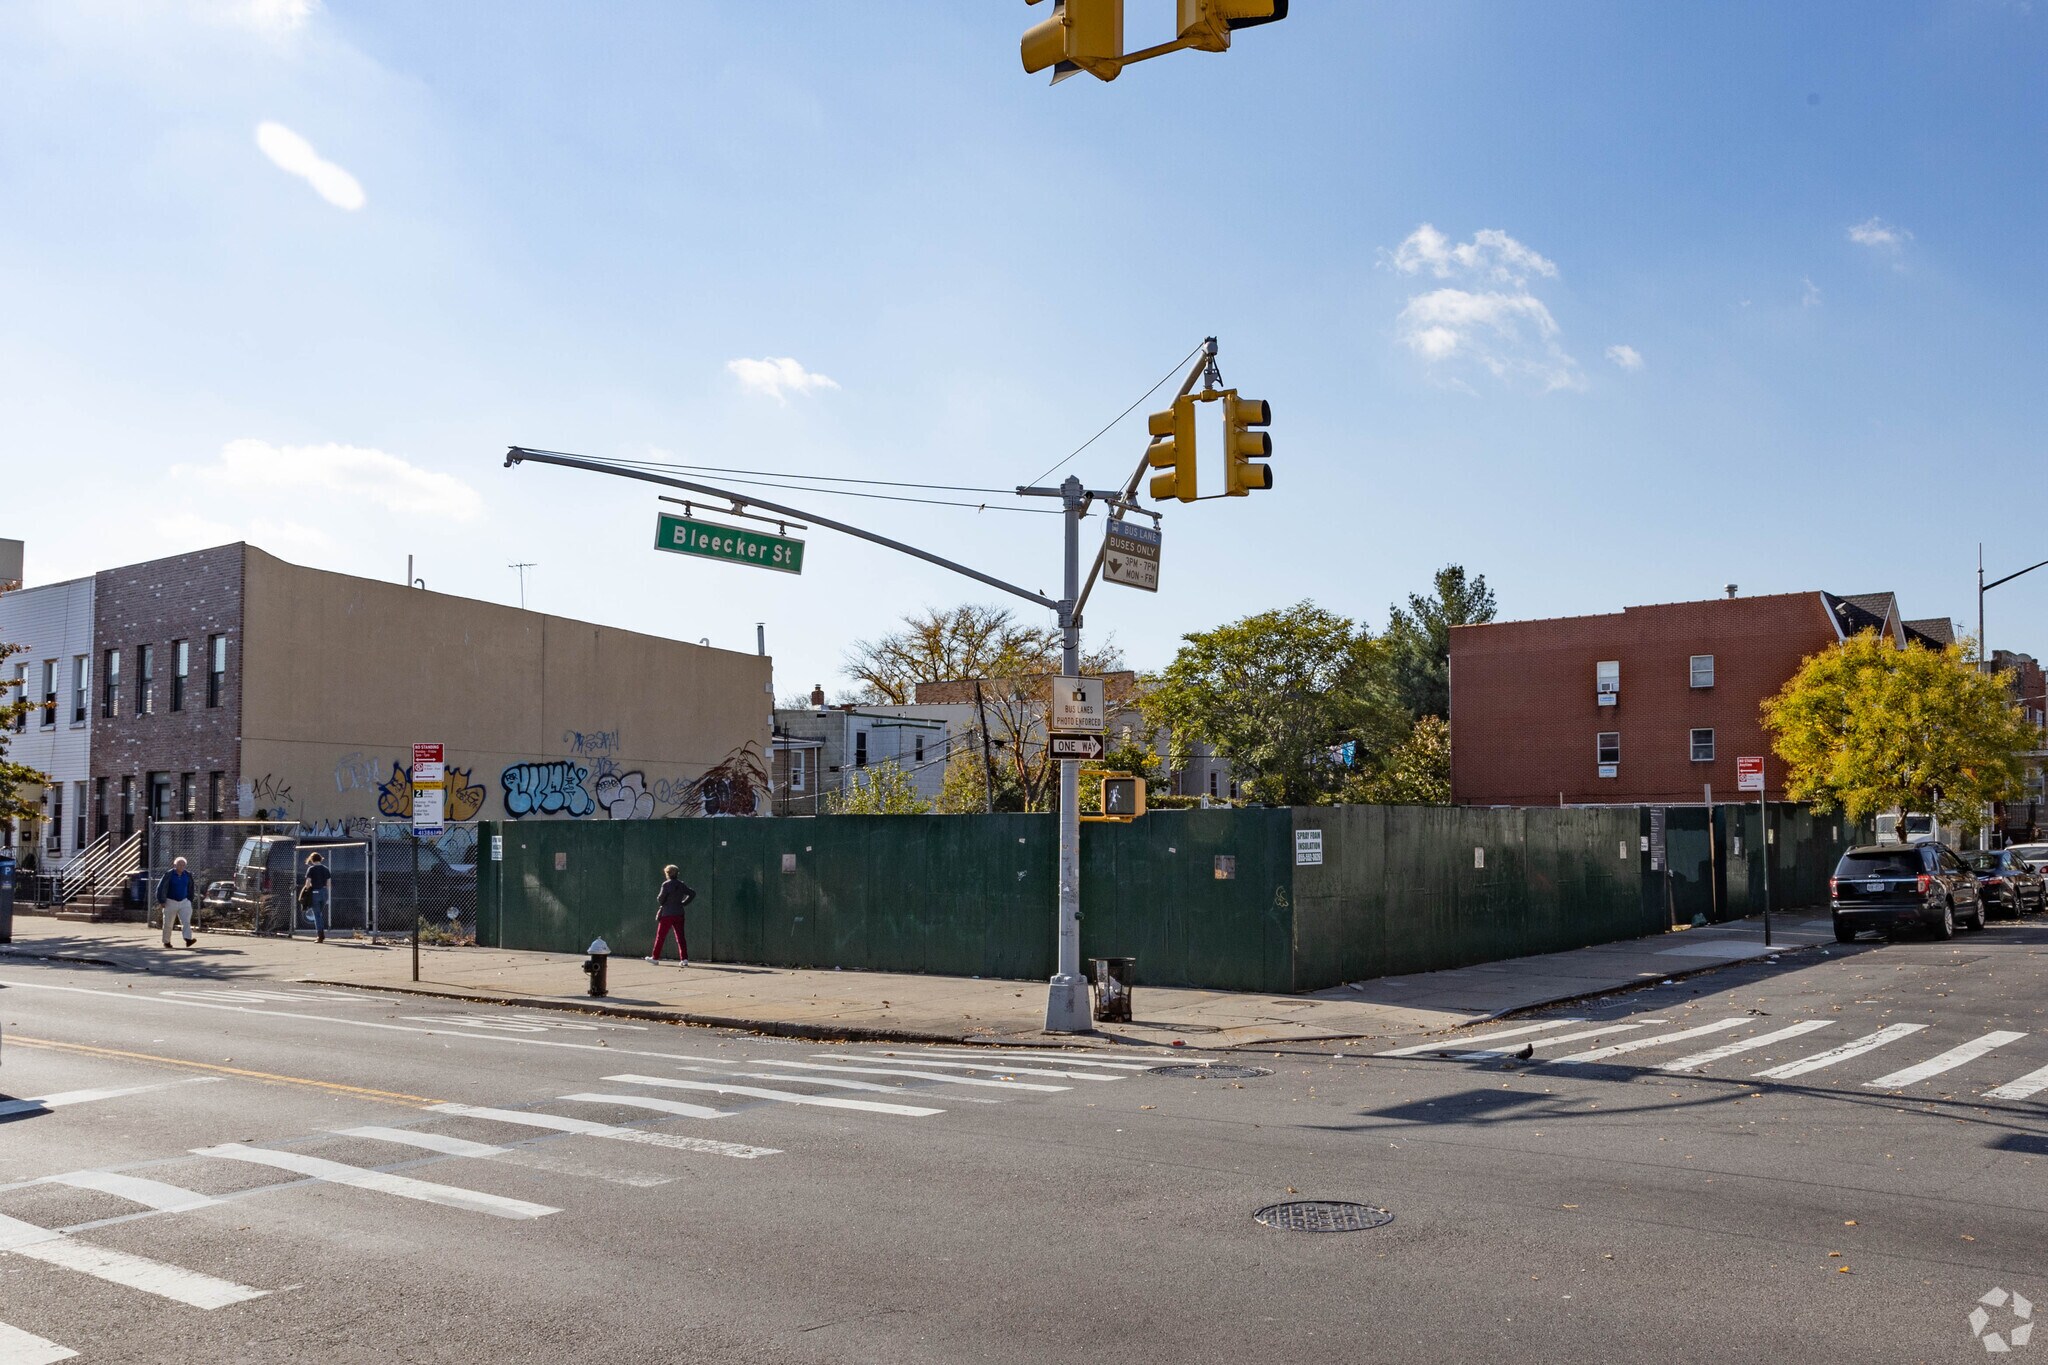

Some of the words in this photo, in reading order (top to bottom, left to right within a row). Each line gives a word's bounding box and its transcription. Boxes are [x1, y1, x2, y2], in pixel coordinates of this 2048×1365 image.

[1124, 525, 1138, 537] BUS
[1139, 529, 1157, 542] LANE
[673, 525, 767, 559] Bleecker
[773, 544, 792, 564] St
[1110, 537, 1134, 551] BUSES
[1136, 544, 1156, 557] ONLY
[1125, 556, 1138, 568] 3PM
[1143, 561, 1156, 572] 7PM
[1125, 568, 1139, 580] MON
[1144, 573, 1155, 584] FRI
[1064, 705, 1076, 714] BUS
[1077, 705, 1094, 714] LANES
[1056, 716, 1074, 725] PHOTO
[1076, 717, 1101, 726] ENFORCED
[1058, 740, 1076, 752] ONE
[1081, 741, 1098, 752] WAY
[1297, 832, 1310, 840] SPRAY
[4, 866, 11, 875] P
